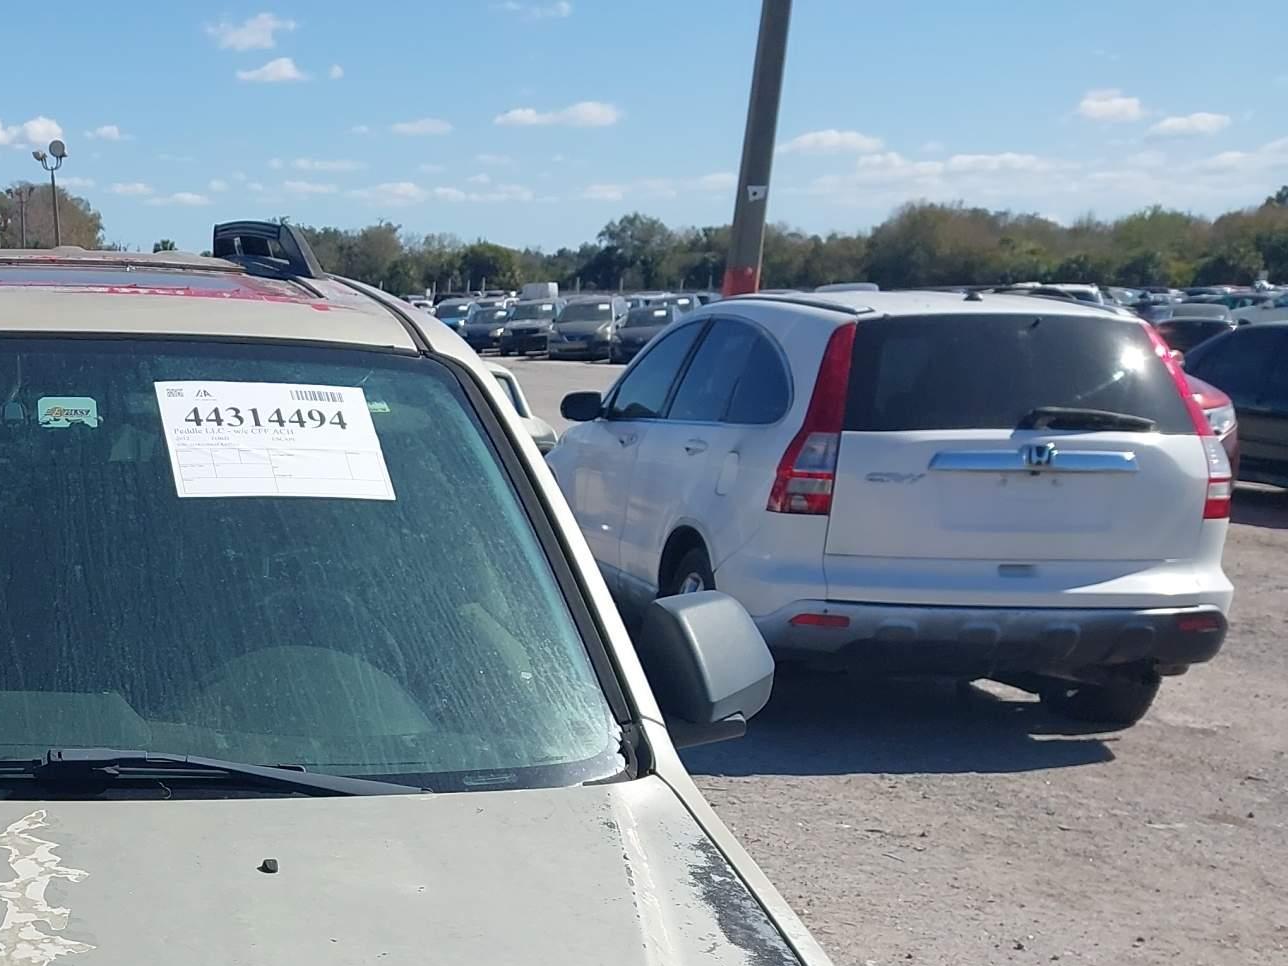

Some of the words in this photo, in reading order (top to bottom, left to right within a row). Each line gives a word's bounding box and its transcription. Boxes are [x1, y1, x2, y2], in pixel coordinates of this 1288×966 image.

[184, 406, 348, 430] 44314494
[174, 427, 203, 435] Peddle
[205, 427, 225, 435] LLC
